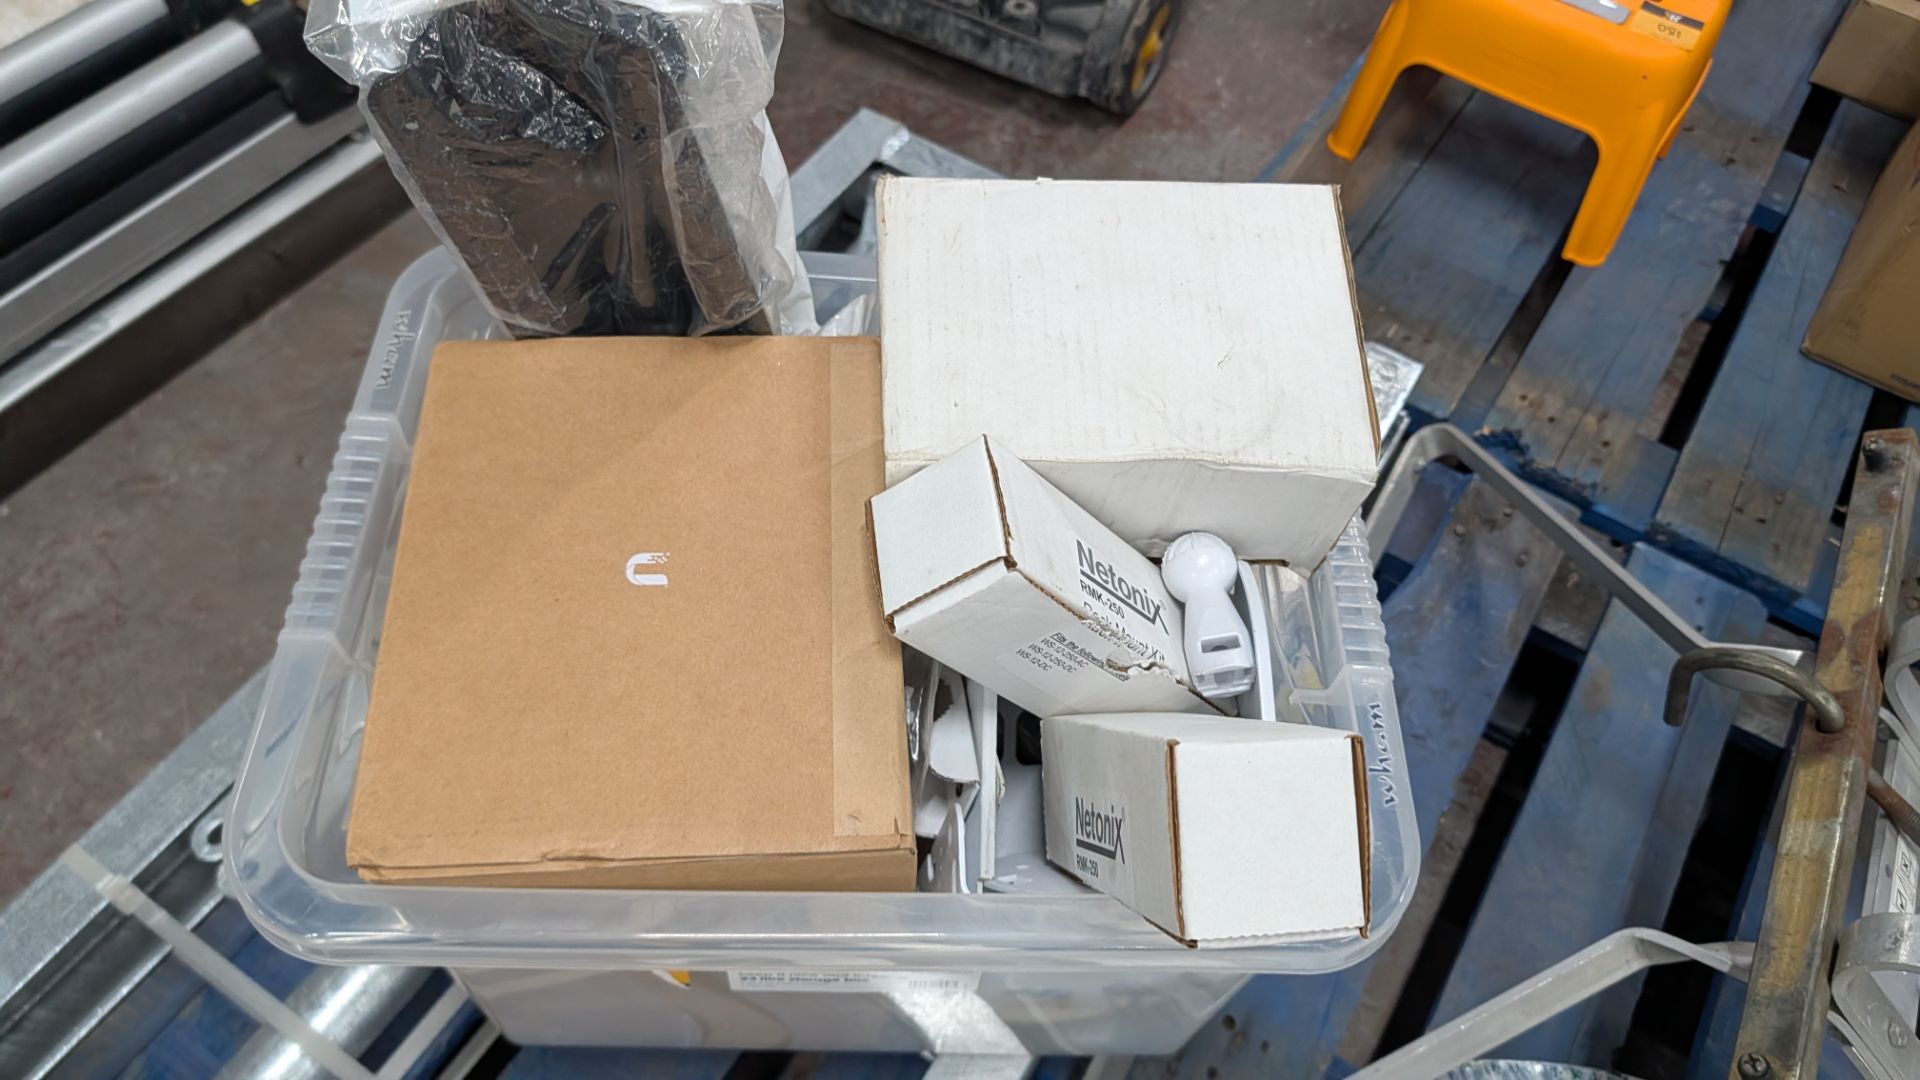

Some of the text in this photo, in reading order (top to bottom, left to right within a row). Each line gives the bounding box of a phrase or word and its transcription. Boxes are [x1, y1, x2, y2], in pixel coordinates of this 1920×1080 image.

[1076, 539, 1169, 635] Netonix
[1079, 578, 1125, 619] RMK-250
[1075, 797, 1125, 864] Netonix
[1076, 853, 1099, 879] RMK-250
